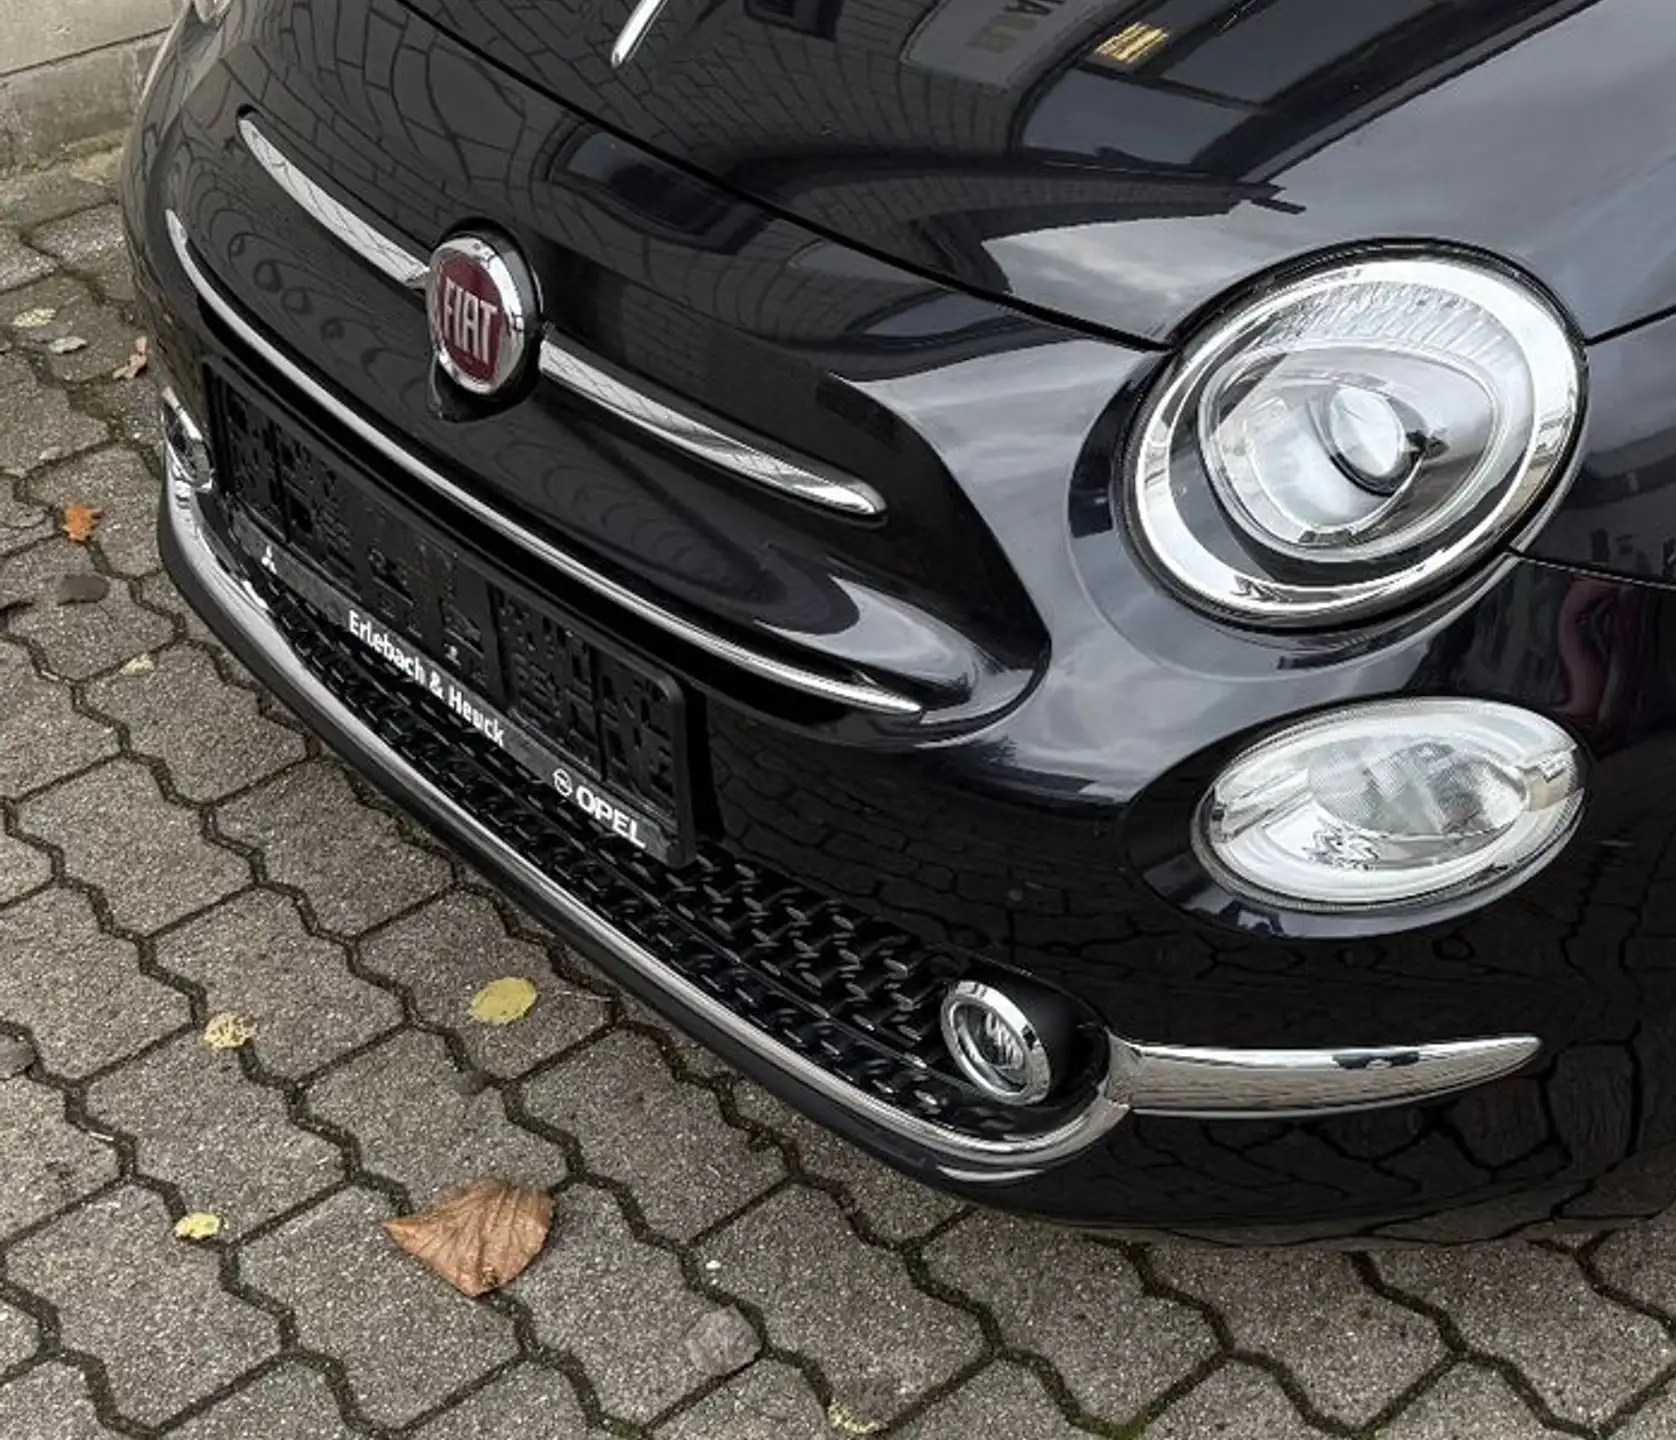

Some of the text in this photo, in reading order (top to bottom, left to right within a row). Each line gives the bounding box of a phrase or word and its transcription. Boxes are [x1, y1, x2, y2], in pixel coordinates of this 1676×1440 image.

[443, 276, 499, 365] FIAT
[349, 610, 426, 690] Erlebach
[428, 671, 444, 702] &
[576, 784, 648, 850] OPEL
